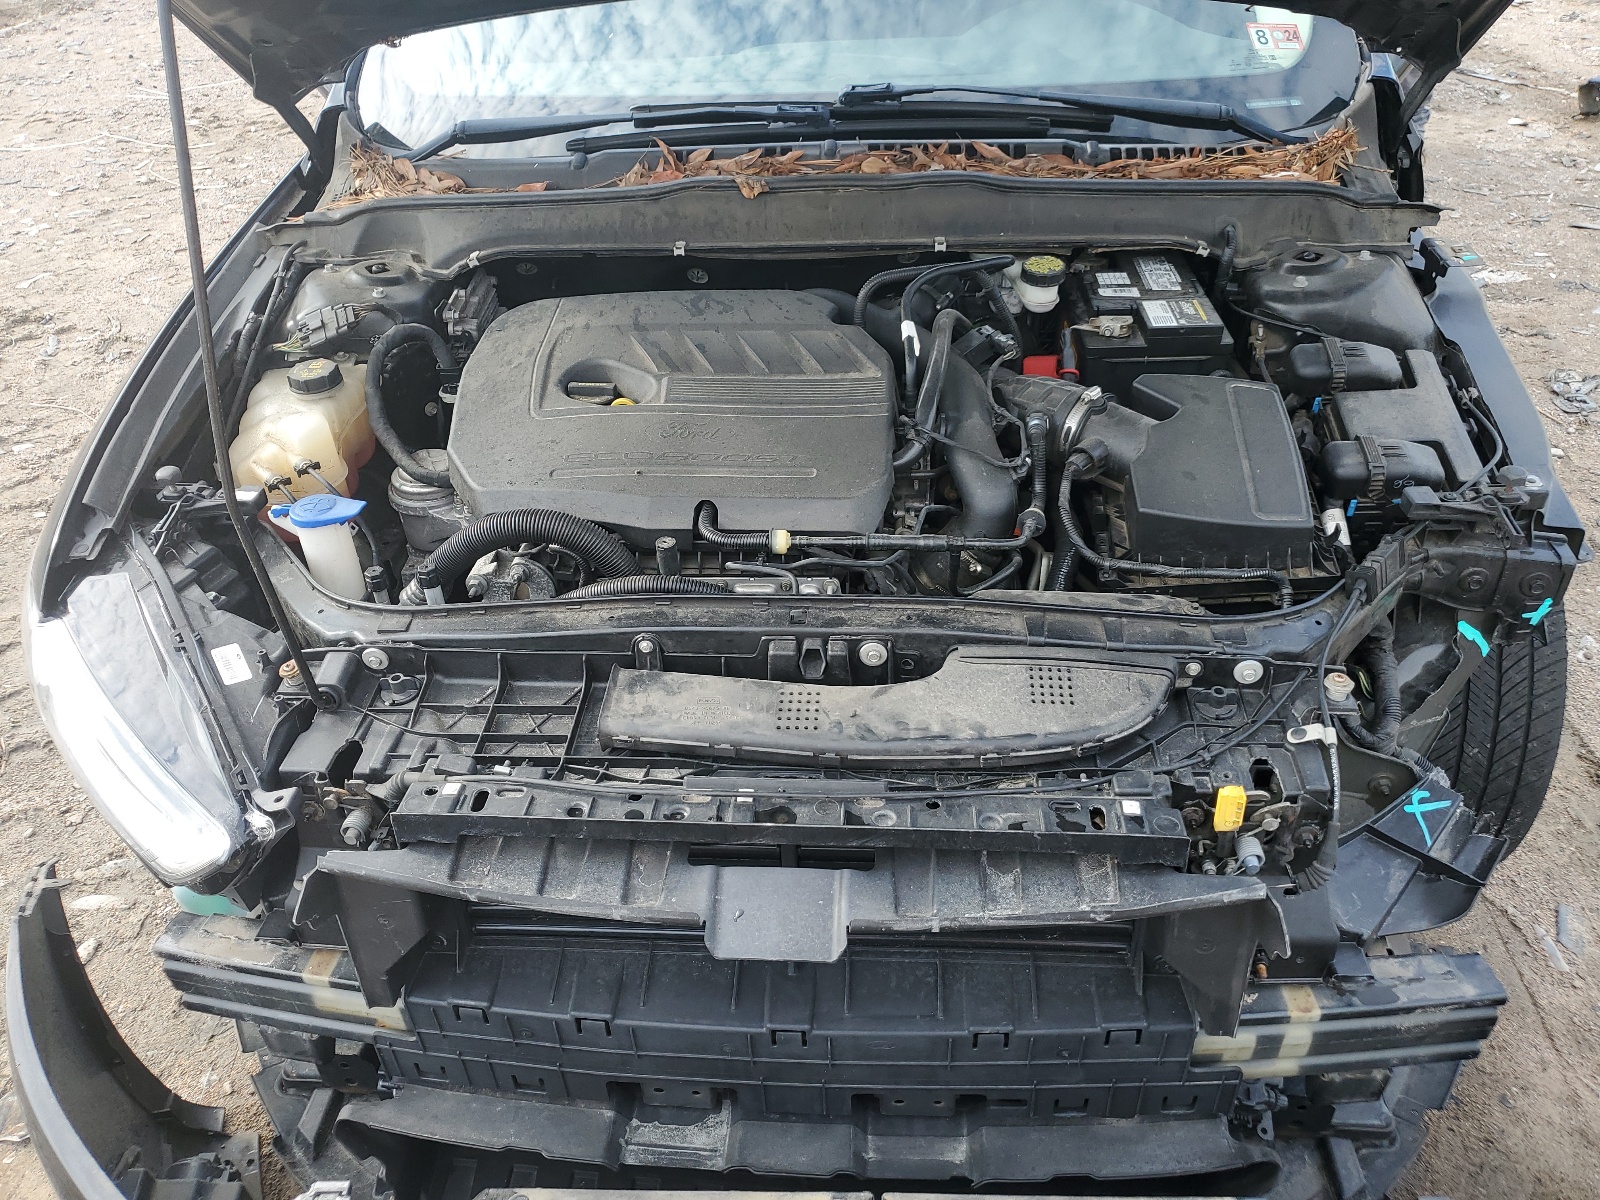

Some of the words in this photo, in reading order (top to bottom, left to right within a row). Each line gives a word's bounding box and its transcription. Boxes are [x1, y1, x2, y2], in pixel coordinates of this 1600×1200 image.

[1255, 29, 1269, 45] 8
[1284, 29, 1300, 42] 24
[658, 420, 721, 440] Ford
